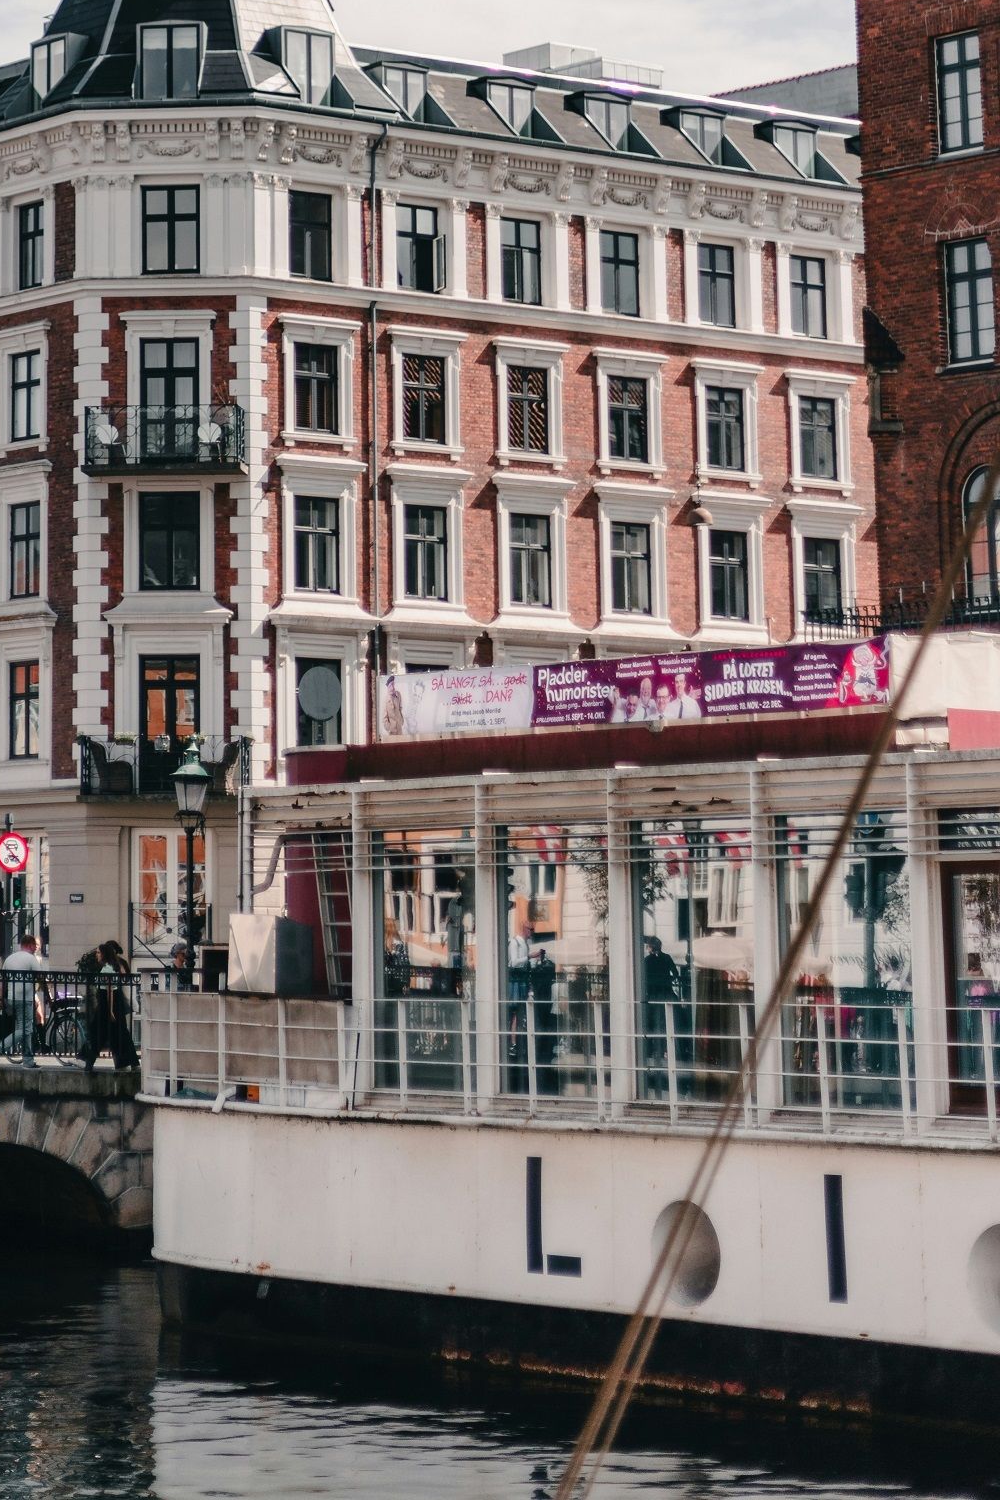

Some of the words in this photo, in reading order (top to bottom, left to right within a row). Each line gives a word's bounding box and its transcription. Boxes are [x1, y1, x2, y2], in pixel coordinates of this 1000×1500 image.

[538, 666, 588, 687] Pladder
[723, 658, 738, 680] PÅ
[739, 662, 775, 678] LOFTET
[432, 675, 444, 690] SÅ
[546, 682, 615, 702] humorister
[705, 681, 745, 702] SIDDER
